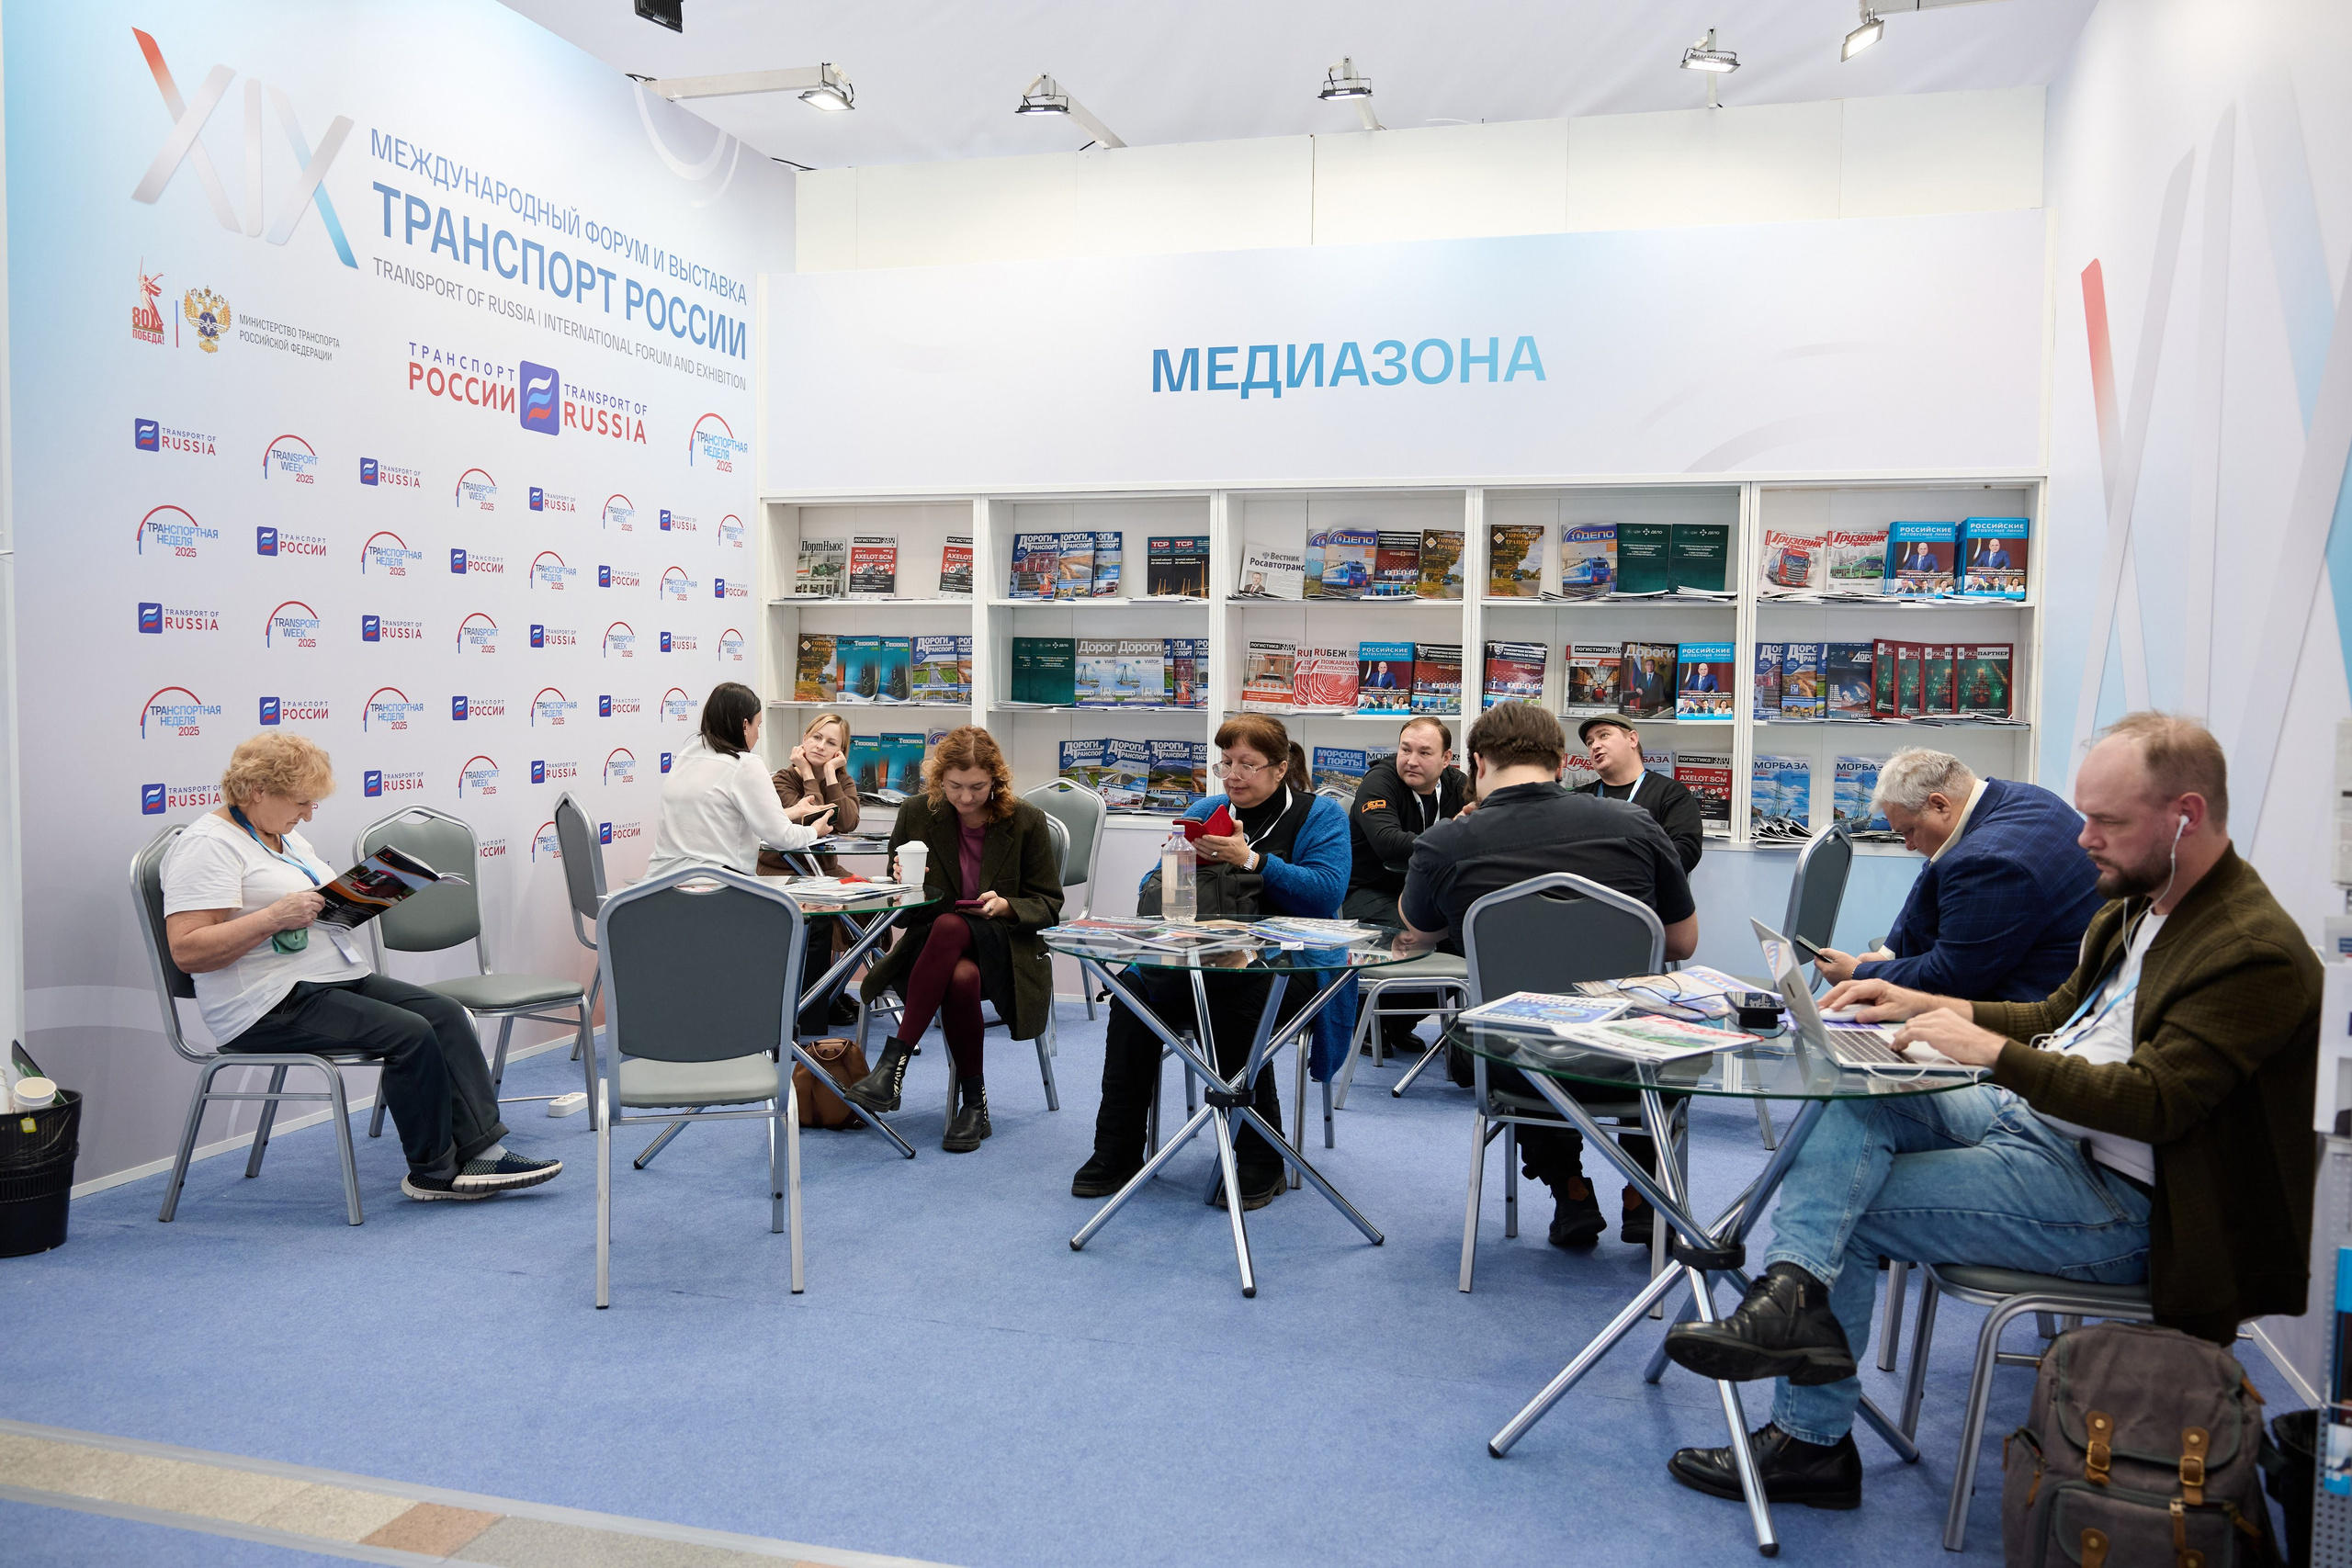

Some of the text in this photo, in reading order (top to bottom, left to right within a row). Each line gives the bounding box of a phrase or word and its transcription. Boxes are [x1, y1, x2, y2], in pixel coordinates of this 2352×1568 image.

[131, 27, 359, 270] XIX
[370, 128, 747, 306] МЕЖДУНАРОДНЫЙ ФОРУМ И ВЫСТАВКА
[373, 181, 747, 361] ТРАНСПОРТ РОССИИ
[373, 256, 746, 390] TRANSPORT OF RUSSIA INTERNATIONAL FORUM AND EXHIBITION
[132, 328, 164, 344] ПОБЕДА!
[239, 314, 340, 348] МИНИСТЕРСТВО ТРАНСПОРТА
[240, 330, 333, 361] РОССИЙСКОЙ ФЕДЕРАЦИИ
[409, 342, 515, 382] ТРАНСПОРТ
[1152, 335, 1547, 400] МЕДИАЗОНА
[409, 362, 515, 414] РОССИИ
[564, 383, 648, 417] TRANSPORT OF
[563, 401, 647, 445] RUSSIA
[163, 428, 204, 440] TRANSPORT
[163, 435, 216, 456] RUSSIA
[696, 431, 748, 454] ТРАНСПОРТНАЯ
[272, 450, 318, 466] TRANSPORT
[704, 444, 729, 461] НЕДЕЛЯ
[281, 461, 304, 473] WEEK
[380, 465, 412, 474] TRANSPORT
[717, 459, 732, 473] 2025
[296, 473, 314, 484] 2025
[380, 472, 421, 488] RUSSIA
[462, 481, 497, 494] TRANSPORT
[469, 491, 487, 502] WEEK
[481, 502, 494, 511] 2025
[544, 499, 576, 513] RUSSIA
[608, 506, 635, 517] TRANSPORT
[613, 514, 627, 523] WEEK
[147, 523, 219, 539] ТРАНСПОРТНАЯ
[622, 524, 632, 532] 2025
[673, 520, 696, 532] RUSSIA
[157, 535, 193, 547] НЕДЕЛЯ
[280, 534, 326, 544] ТРАНСПОРТ
[1771, 531, 1825, 547] Грузовик
[1834, 531, 1887, 544] Грузовик
[280, 541, 326, 556] РОССИИ
[801, 540, 843, 553] ПортНьюс
[175, 547, 197, 558] 2025
[368, 547, 422, 560] ТРАНСПОРТНАЯ
[468, 554, 503, 562] ТРАНСПОРТ
[1271, 552, 1299, 562] Вестник
[376, 557, 403, 567] НЕДЕЛЯ
[468, 560, 503, 573] РОССИИ
[1250, 557, 1305, 572] Росавтотранс
[390, 567, 406, 576] 2025
[536, 564, 576, 576] ТРАНСПОРТНАЯ
[612, 570, 639, 578] ТРАНСПОРТ
[541, 573, 562, 582] НЕДЕЛЯ
[612, 576, 639, 586] РОССИИ
[551, 581, 563, 590] 2025
[165, 617, 219, 631] RUSSIA
[275, 617, 320, 628] TRANSPORT
[283, 628, 306, 637] WEEK
[382, 626, 422, 639] RUSSIA
[464, 626, 498, 637] TRANSPORT
[299, 638, 316, 648] 2025
[470, 636, 488, 645] WEEK
[546, 635, 576, 646] RUSSIA
[608, 635, 635, 644] TRANSPORT
[673, 640, 696, 650] RUSSIA
[481, 645, 495, 653] 2025
[1118, 641, 1161, 654] Дороги
[1624, 644, 1676, 659] Дороги
[150, 705, 221, 716] ТРАНСПОРТНАЯ
[370, 703, 424, 712] ТРАНСПОРТНАЯ
[469, 705, 504, 716] РОССИИ
[537, 701, 577, 711] ТРАНСПОРТНАЯ
[613, 704, 640, 713] РОССИИ
[283, 708, 329, 719] РОССИИ
[379, 712, 404, 721] НЕДЕЛЯ
[542, 708, 562, 717] НЕДЕЛЯ
[160, 716, 195, 727] НЕДЕЛЯ
[391, 721, 407, 730] 2025
[552, 716, 564, 725] 2025
[178, 726, 199, 736] 2025
[1317, 750, 1363, 759] МОРСКИЕ
[1327, 758, 1363, 767] ПОРТЫ
[1754, 761, 1808, 770] МОРБАЗА
[465, 769, 499, 779] TRANSPORT
[546, 766, 577, 778] RUSSIA
[384, 779, 424, 791] RUSSIA
[471, 778, 489, 787] WEEK
[483, 786, 496, 795] 2025
[168, 794, 221, 807] RUSSIA
[613, 828, 640, 839] РОССИИ
